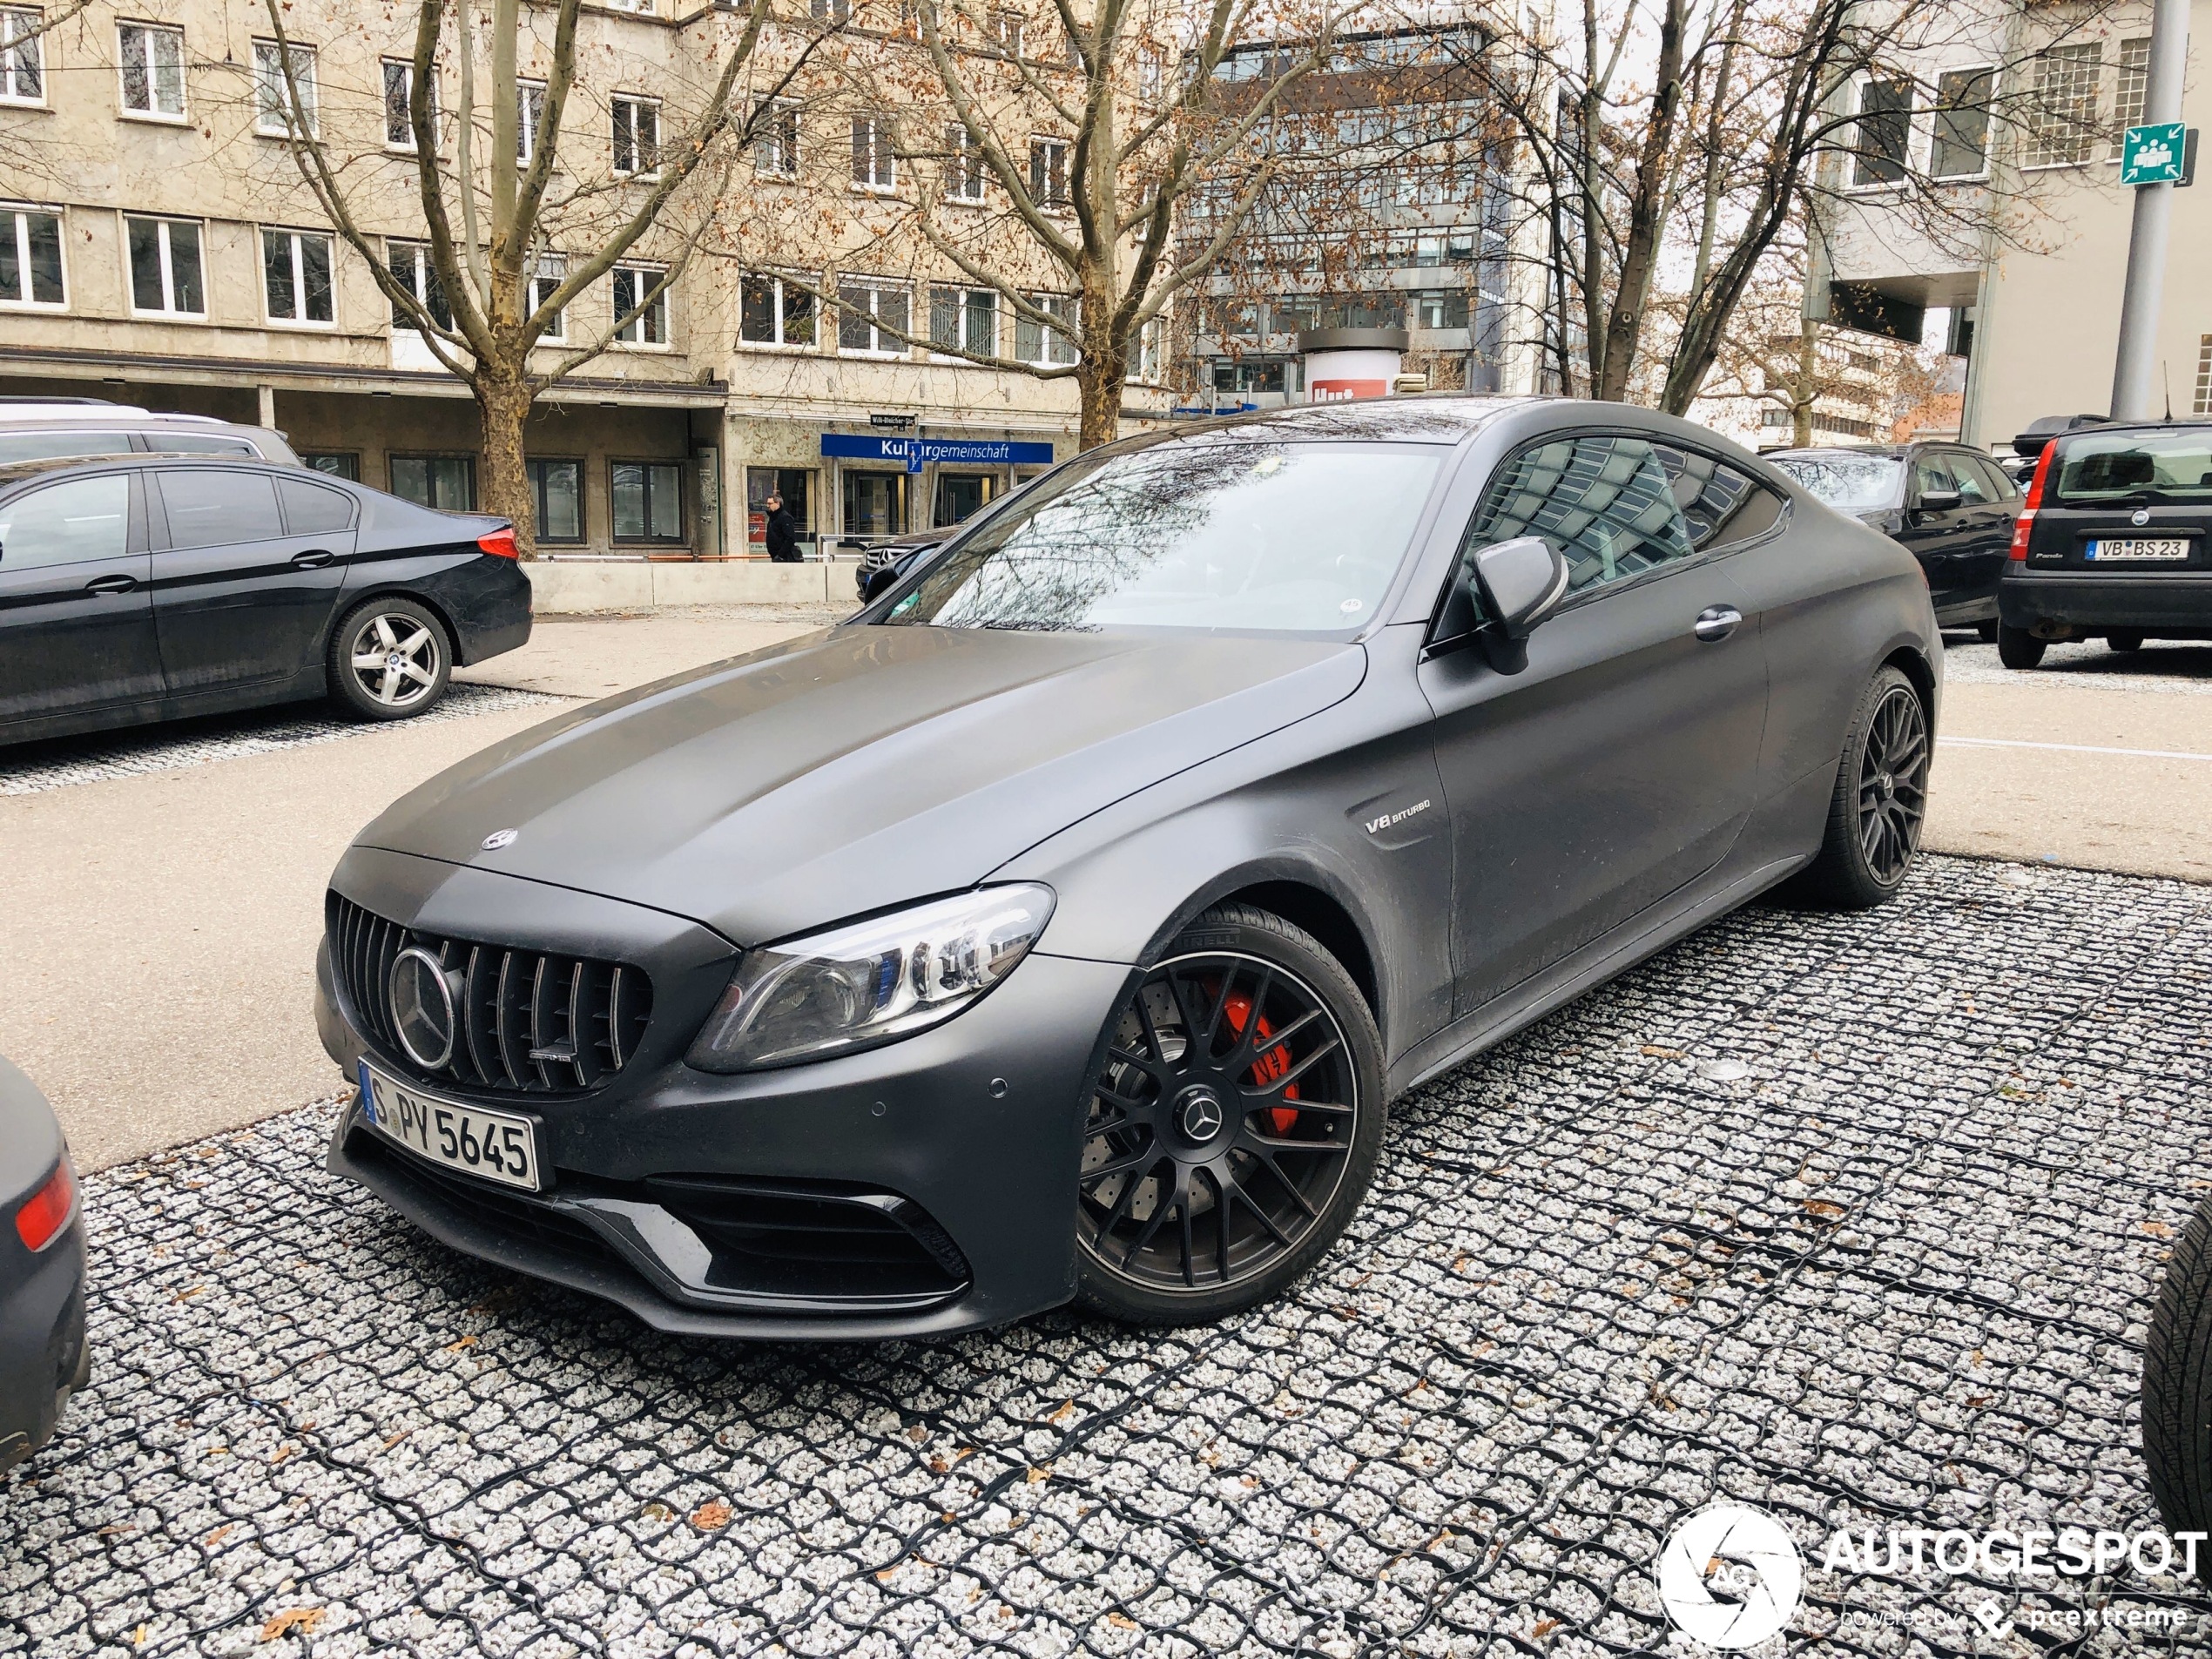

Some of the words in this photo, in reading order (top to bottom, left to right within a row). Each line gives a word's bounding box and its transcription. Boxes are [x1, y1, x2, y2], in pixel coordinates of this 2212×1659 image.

[881, 440, 1009, 460] Kulrgemeinschaft
[2102, 542, 2123, 556] VB
[2134, 542, 2156, 556] BS
[2160, 542, 2182, 556] 23
[1366, 814, 1392, 834] V8
[1393, 799, 1430, 823] BITURBO
[372, 1077, 388, 1124] S
[396, 1091, 428, 1150] PY
[435, 1109, 528, 1177] 5645
